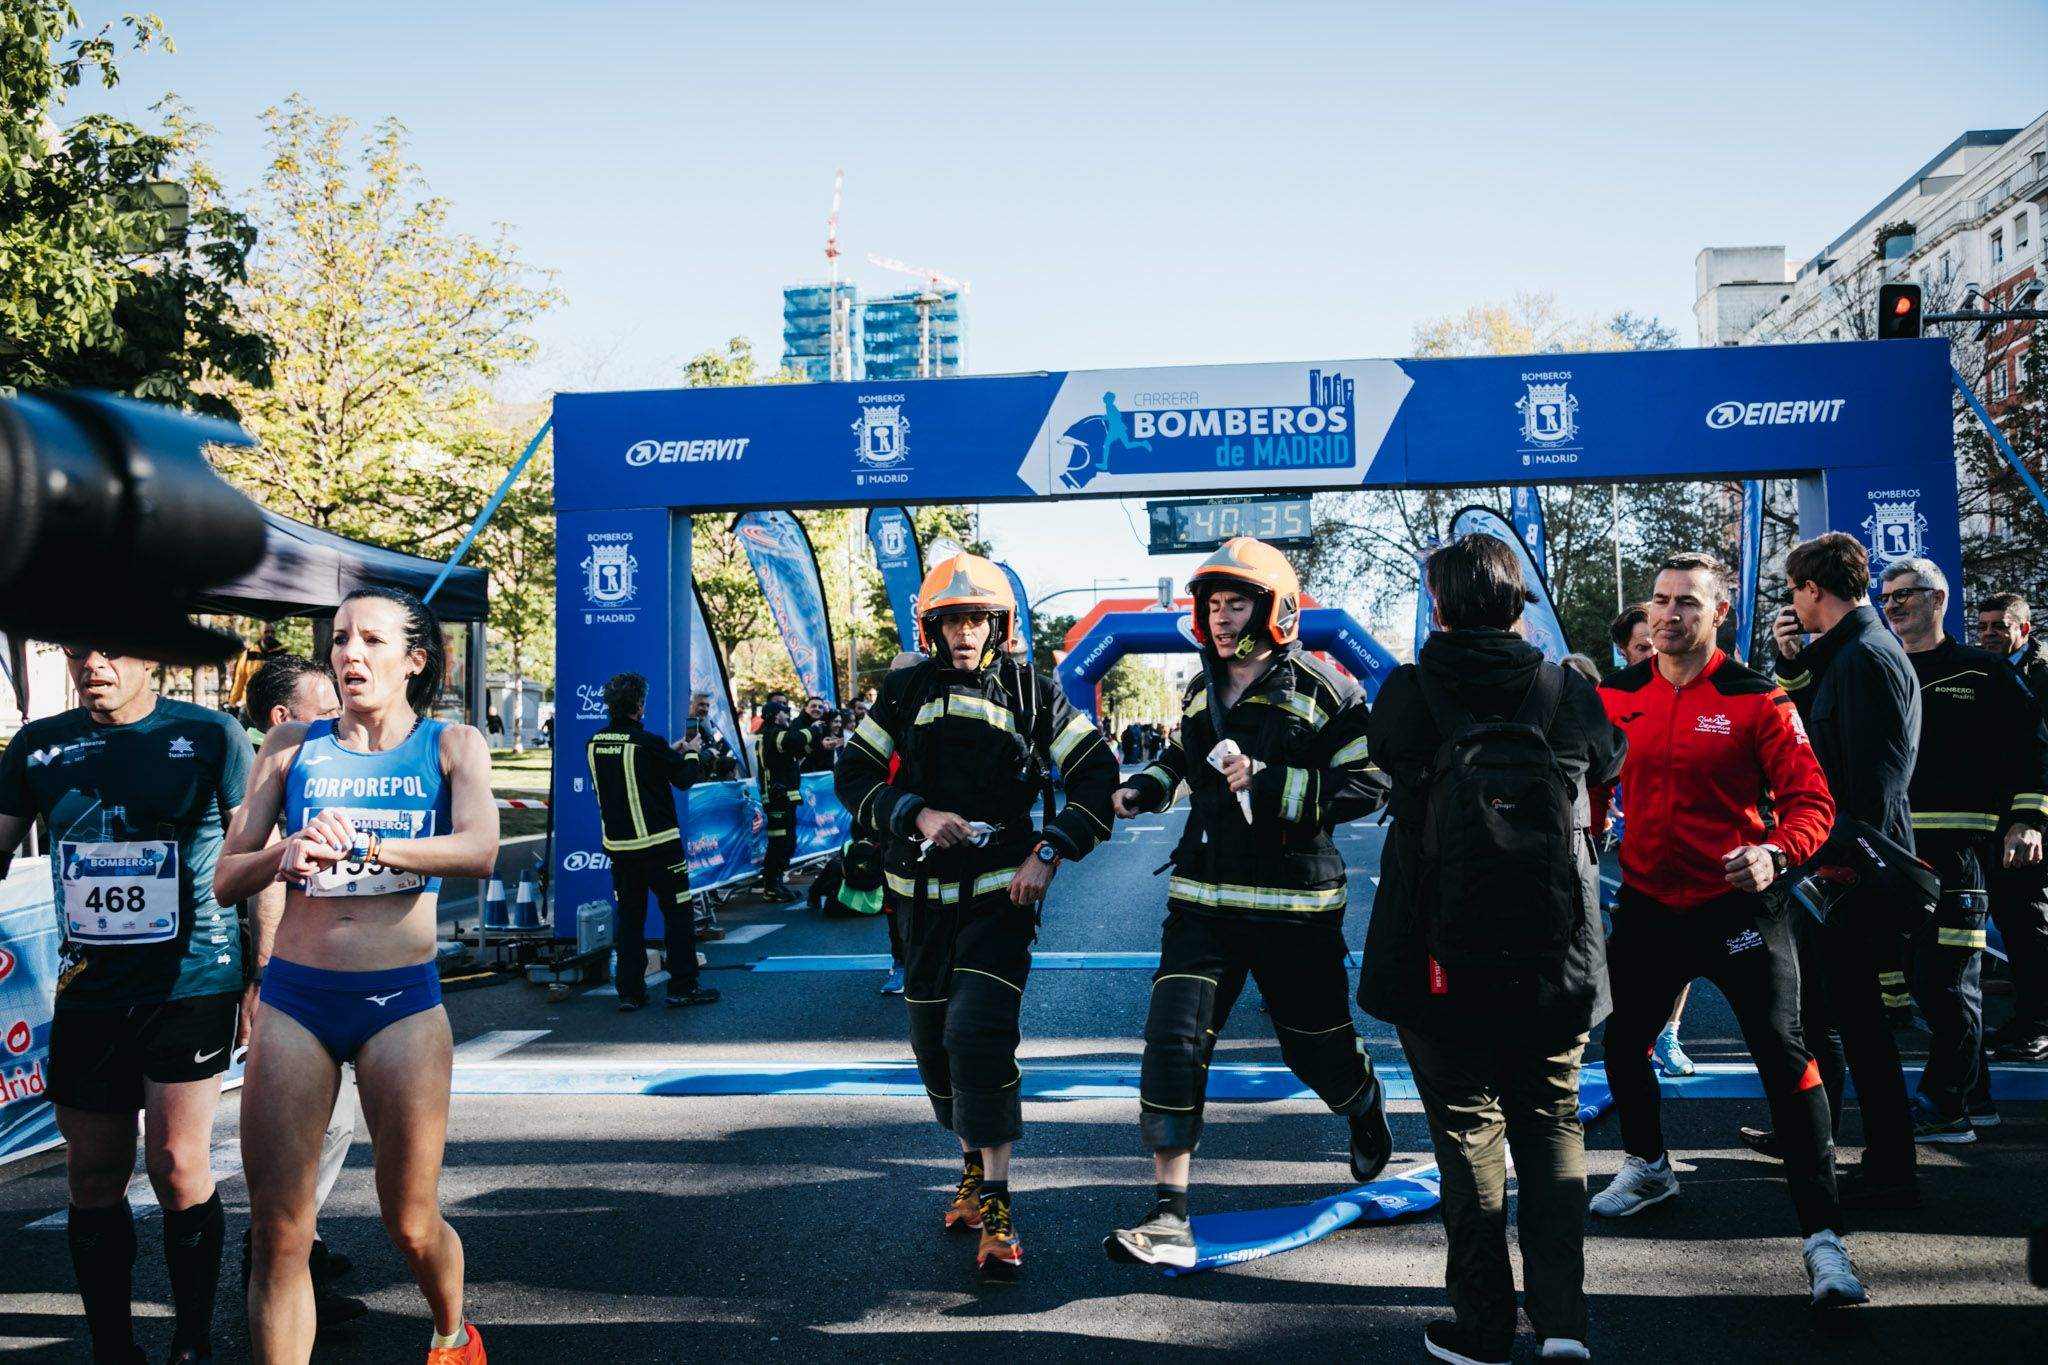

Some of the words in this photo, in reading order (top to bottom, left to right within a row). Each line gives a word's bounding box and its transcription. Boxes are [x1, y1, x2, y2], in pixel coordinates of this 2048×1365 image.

[1521, 371, 1572, 381] BOMBEROS
[858, 394, 906, 404] BOMBEROS
[1133, 391, 1200, 407] CARRERA
[1743, 399, 1846, 426] ENERVIT
[1133, 405, 1349, 439] BOMBEROS
[658, 438, 750, 464] ENERVIT
[1215, 438, 1245, 467] de
[1253, 434, 1350, 466] MADRID
[1535, 453, 1578, 465] MADRID
[868, 473, 909, 485] MADRID
[1867, 488, 1921, 499] BOMBEROS
[587, 532, 634, 542] BOMBEROS
[596, 613, 636, 623] MADRID
[1083, 634, 1114, 668] MADRID
[1347, 637, 1381, 669] MADRID
[303, 775, 428, 799] CORPOREPOL
[351, 819, 410, 831] OMBEROS
[90, 857, 155, 868] BOMBEROS
[85, 885, 146, 914] 468
[0, 1062, 47, 1102] drid
